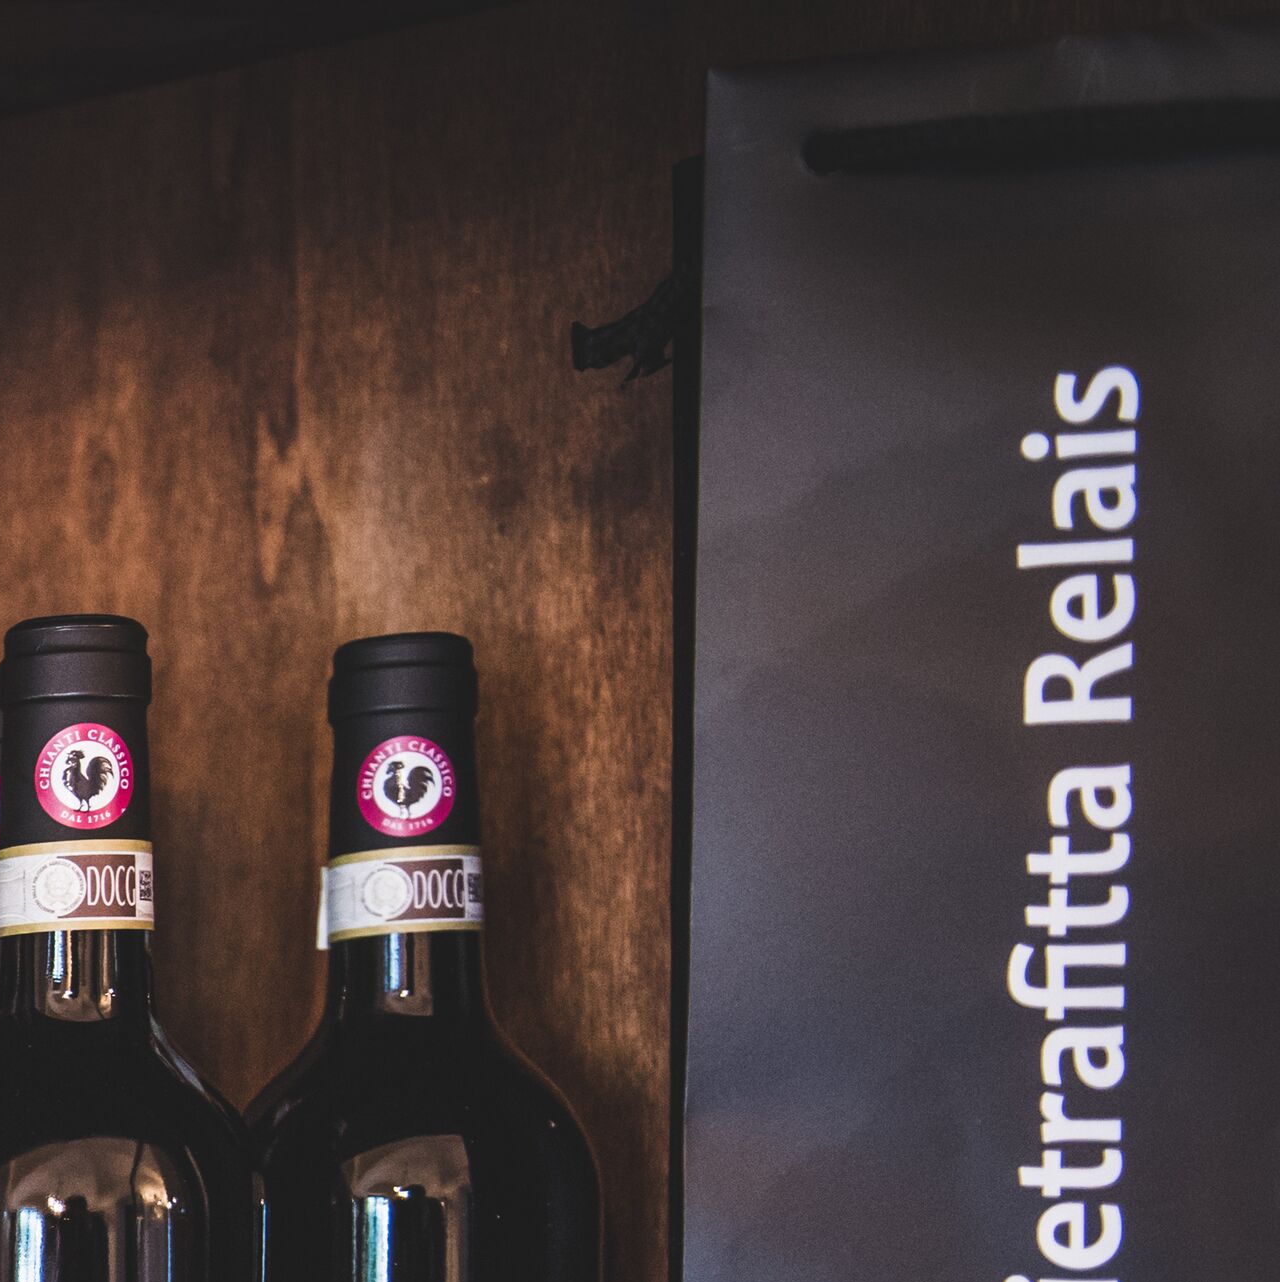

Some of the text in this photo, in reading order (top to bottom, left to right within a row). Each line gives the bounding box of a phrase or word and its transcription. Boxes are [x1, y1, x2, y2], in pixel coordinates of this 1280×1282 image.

[1017, 363, 1141, 727] Relais
[39, 730, 81, 790] CHIANTI
[87, 728, 129, 790] CLASSICO
[362, 740, 453, 801] CHIANTI CLASSICO
[60, 810, 112, 824] DAL 1716
[86, 865, 136, 906] DOCG
